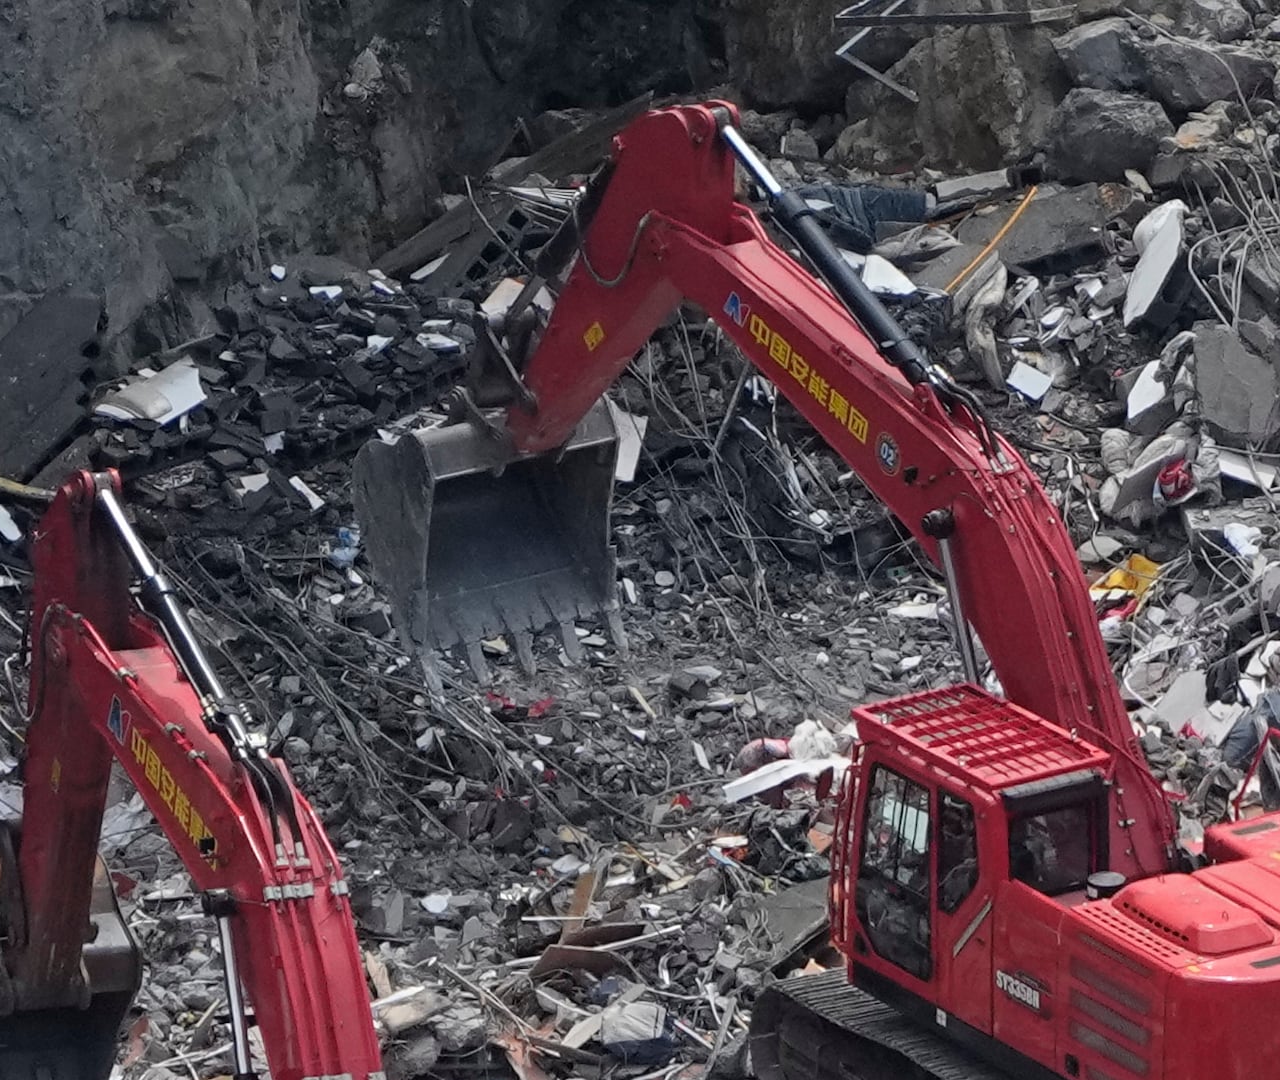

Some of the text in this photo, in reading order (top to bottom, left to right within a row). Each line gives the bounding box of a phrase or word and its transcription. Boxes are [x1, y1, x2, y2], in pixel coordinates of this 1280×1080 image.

[749, 314, 869, 445] 中国安能集团
[880, 442, 893, 466] 02
